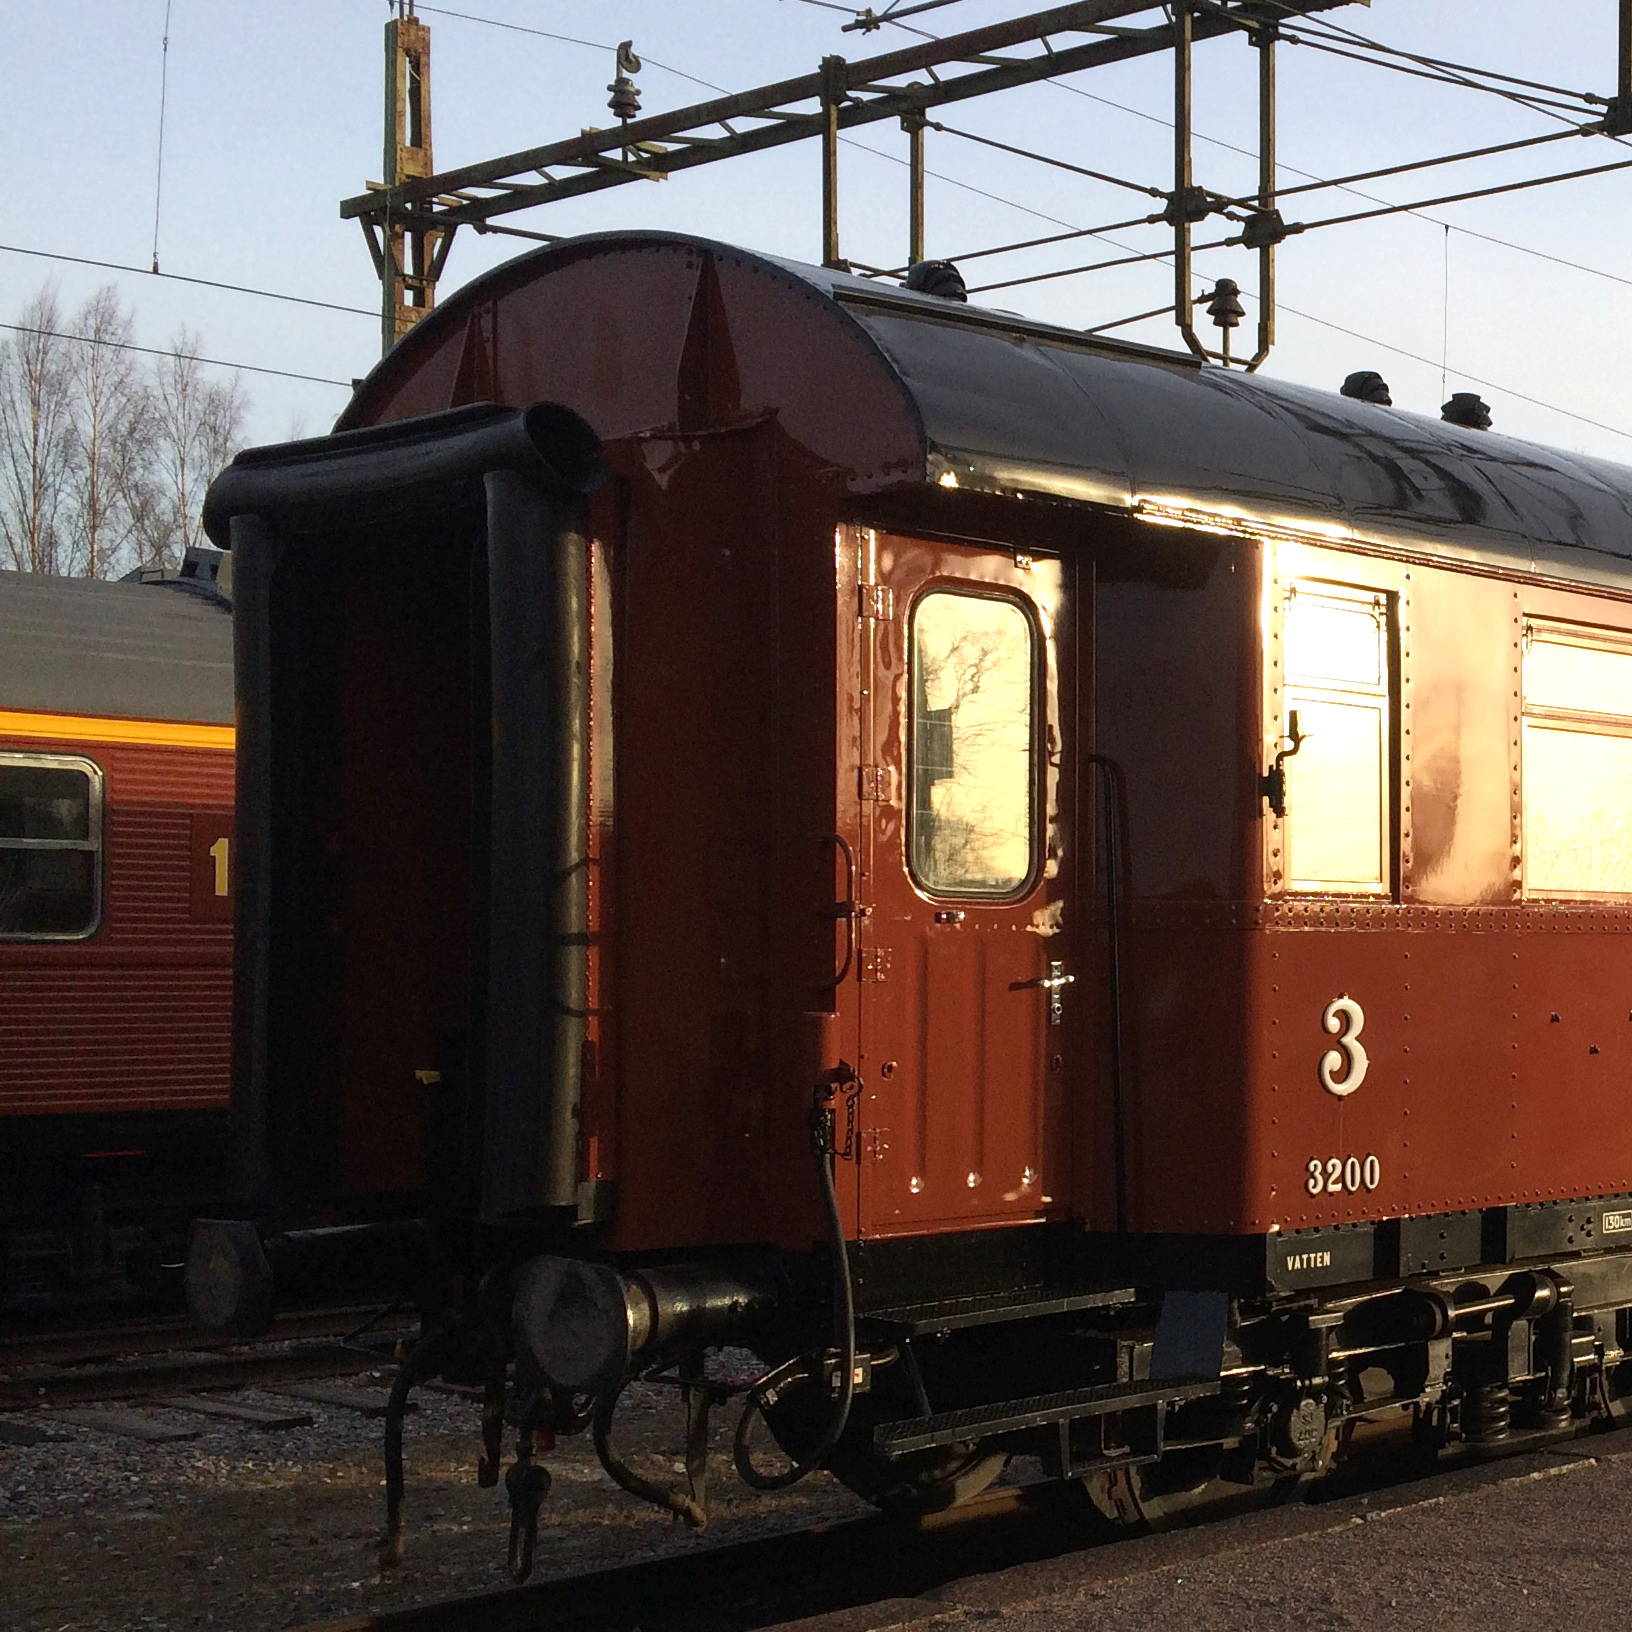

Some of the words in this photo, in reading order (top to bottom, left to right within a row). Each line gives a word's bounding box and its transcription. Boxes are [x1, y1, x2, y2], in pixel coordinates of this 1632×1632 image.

[209, 837, 229, 897] 1
[1320, 995, 1370, 1097] 3
[1306, 1155, 1381, 1195] 3200
[1286, 1251, 1331, 1271] VATTEN
